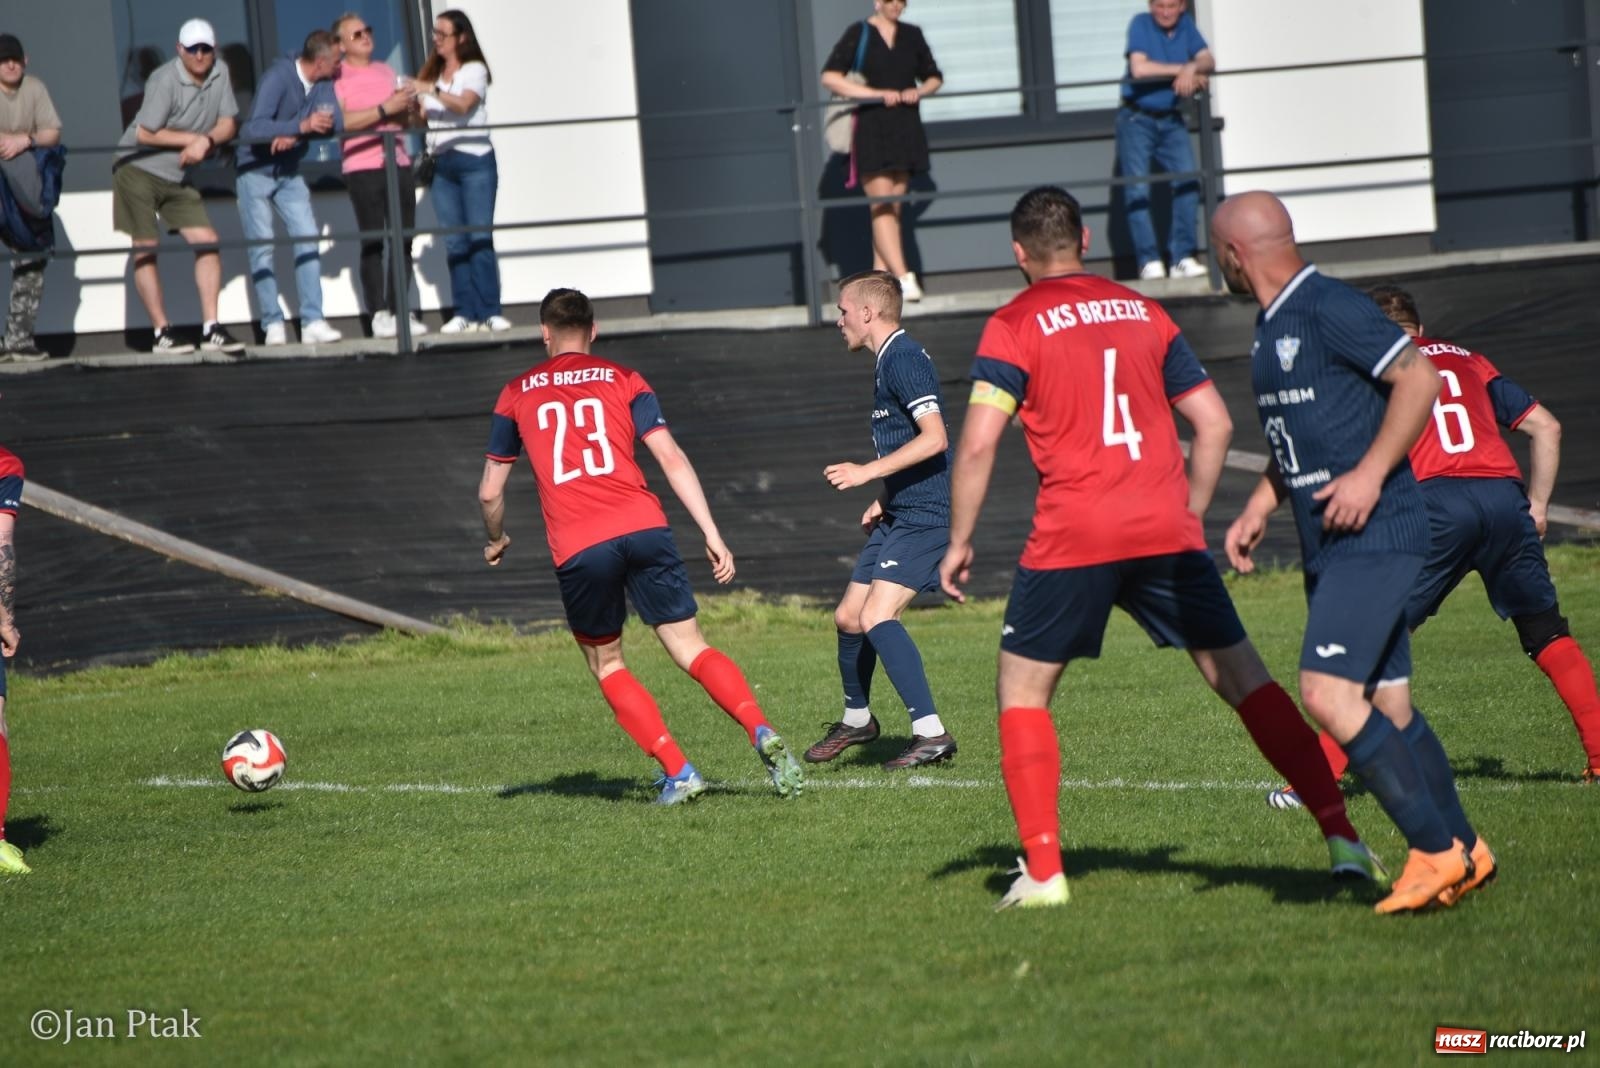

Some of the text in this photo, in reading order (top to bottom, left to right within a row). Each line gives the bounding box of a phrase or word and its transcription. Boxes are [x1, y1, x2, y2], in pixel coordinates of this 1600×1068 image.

[1036, 299, 1151, 336] LKS BRZEZIE
[521, 367, 615, 392] LKS BRZEZIE
[1103, 348, 1143, 460] 4
[1433, 369, 1475, 454] 6
[537, 397, 615, 485] 23
